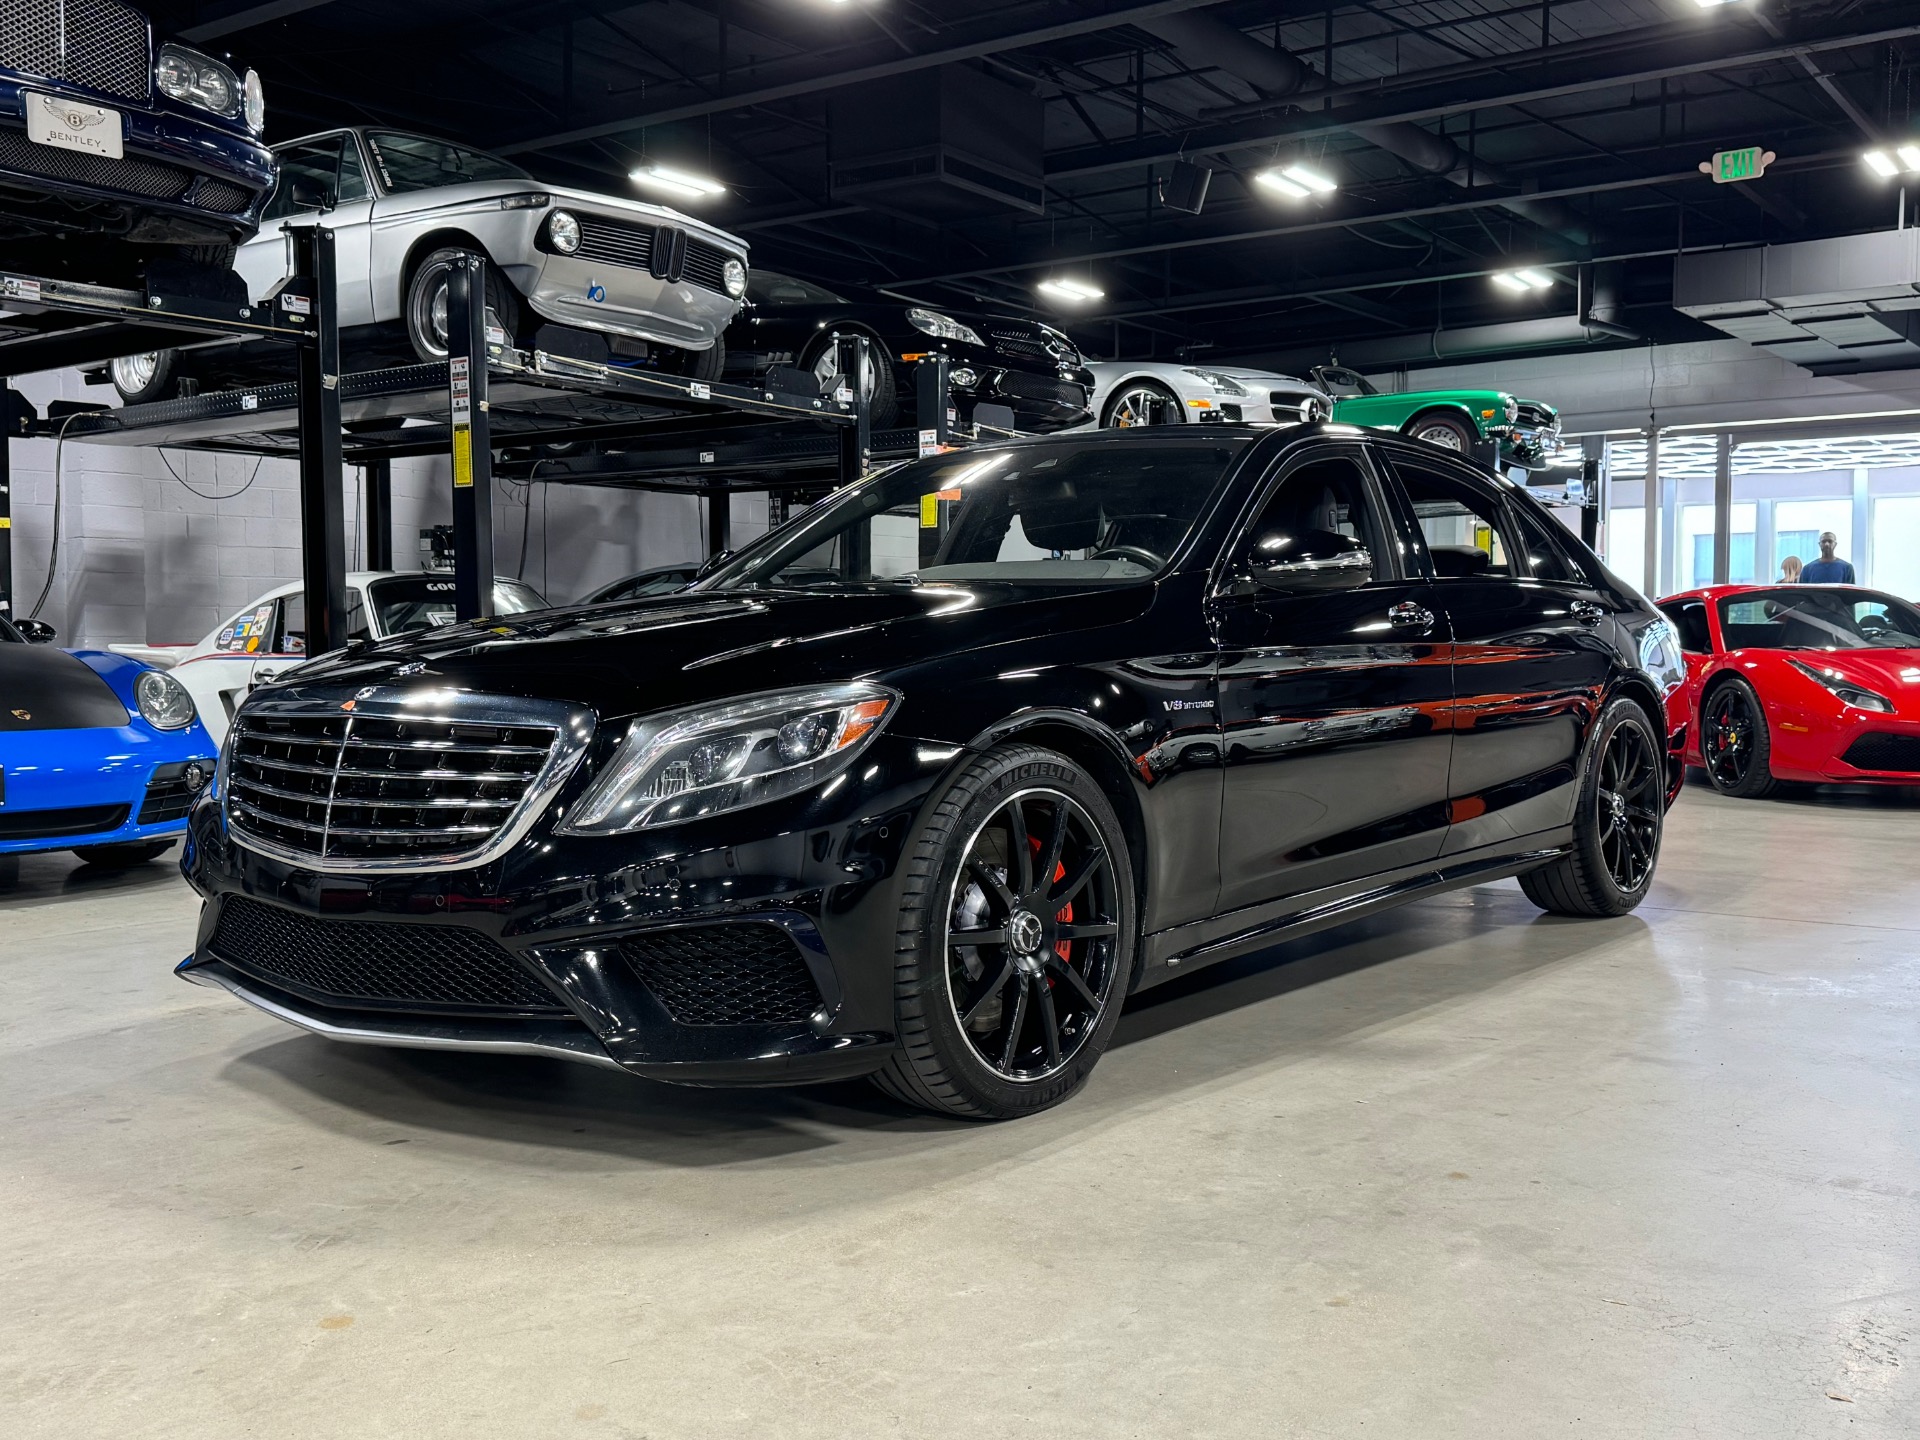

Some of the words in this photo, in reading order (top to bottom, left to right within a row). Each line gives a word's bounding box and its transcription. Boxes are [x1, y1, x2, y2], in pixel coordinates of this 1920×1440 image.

[50, 130, 102, 147] BENTLEY
[1721, 149, 1756, 179] EXIT
[426, 583, 456, 591] GOO
[1163, 700, 1182, 711] V8
[1000, 763, 1075, 788] MICHELIN
